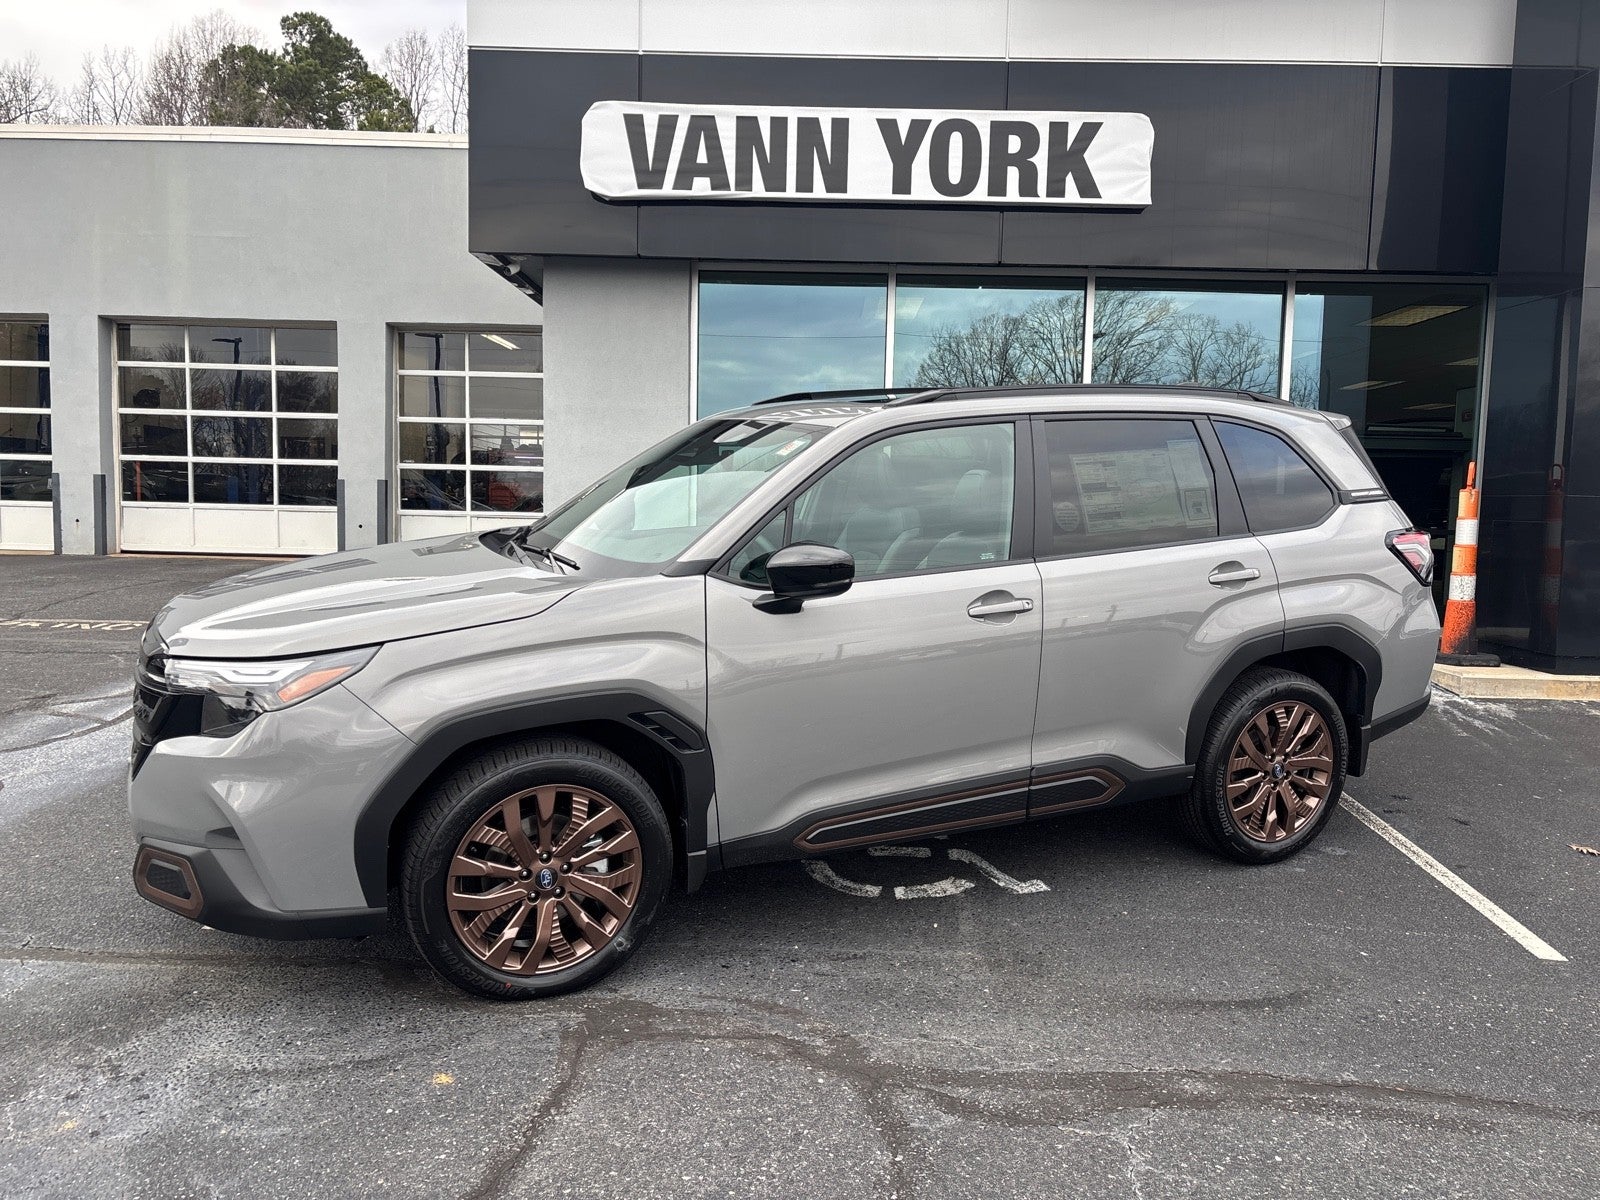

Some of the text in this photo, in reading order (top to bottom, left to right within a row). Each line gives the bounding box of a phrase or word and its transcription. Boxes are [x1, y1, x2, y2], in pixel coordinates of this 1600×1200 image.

[623, 113, 1104, 199] VANN YORK
[1215, 763, 1235, 836] BRIDGESTONE
